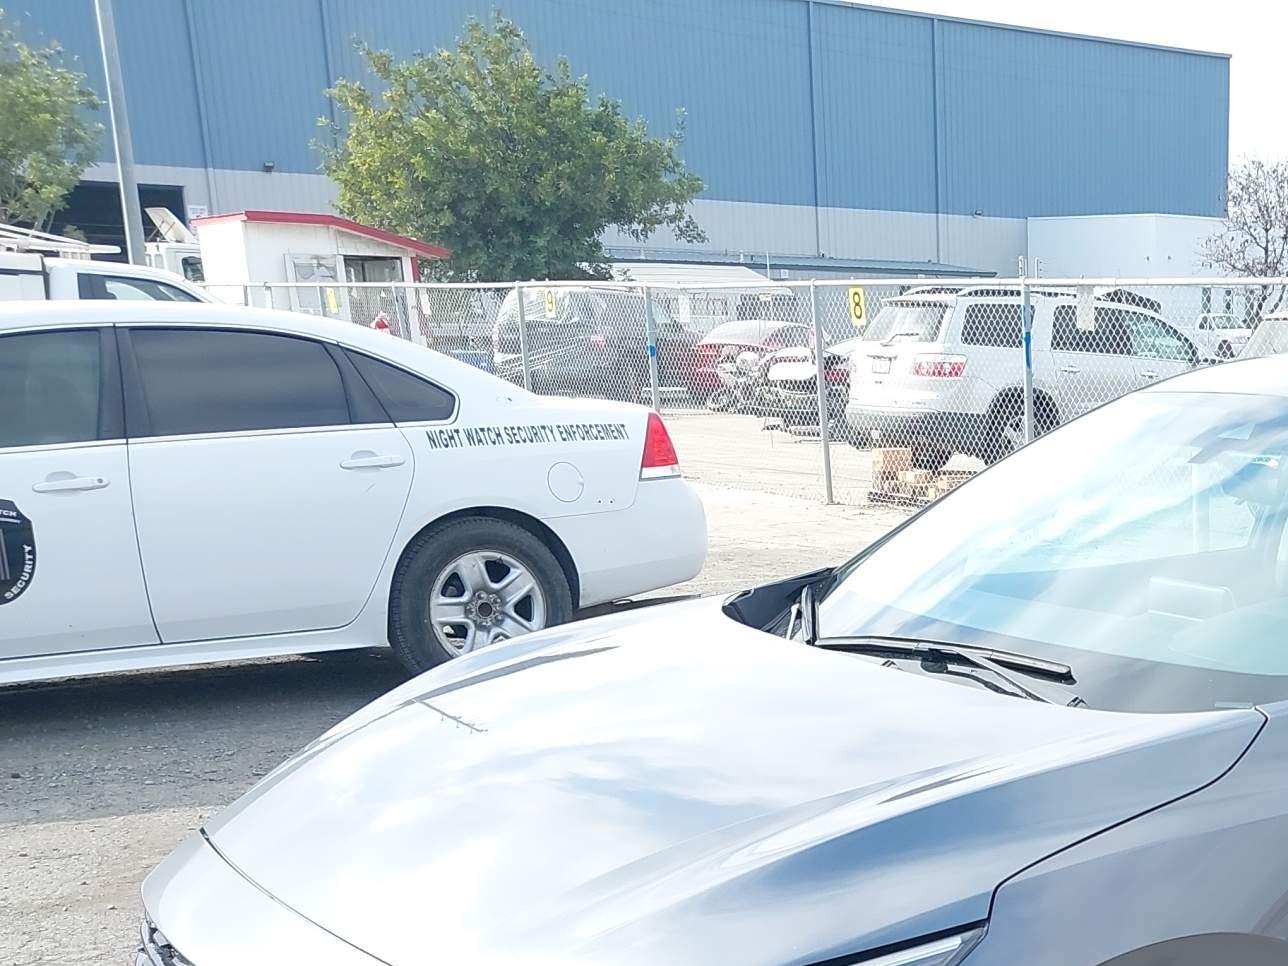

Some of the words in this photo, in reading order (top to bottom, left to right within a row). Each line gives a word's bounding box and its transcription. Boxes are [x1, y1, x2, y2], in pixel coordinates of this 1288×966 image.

[547, 290, 554, 313] 9
[852, 291, 863, 320] 8
[425, 429, 465, 449] NIGHT
[463, 426, 505, 447] WATCH
[503, 424, 557, 444] SECURITY
[556, 423, 630, 441] ENFORCEMENT
[4, 544, 34, 600] SECURITY
